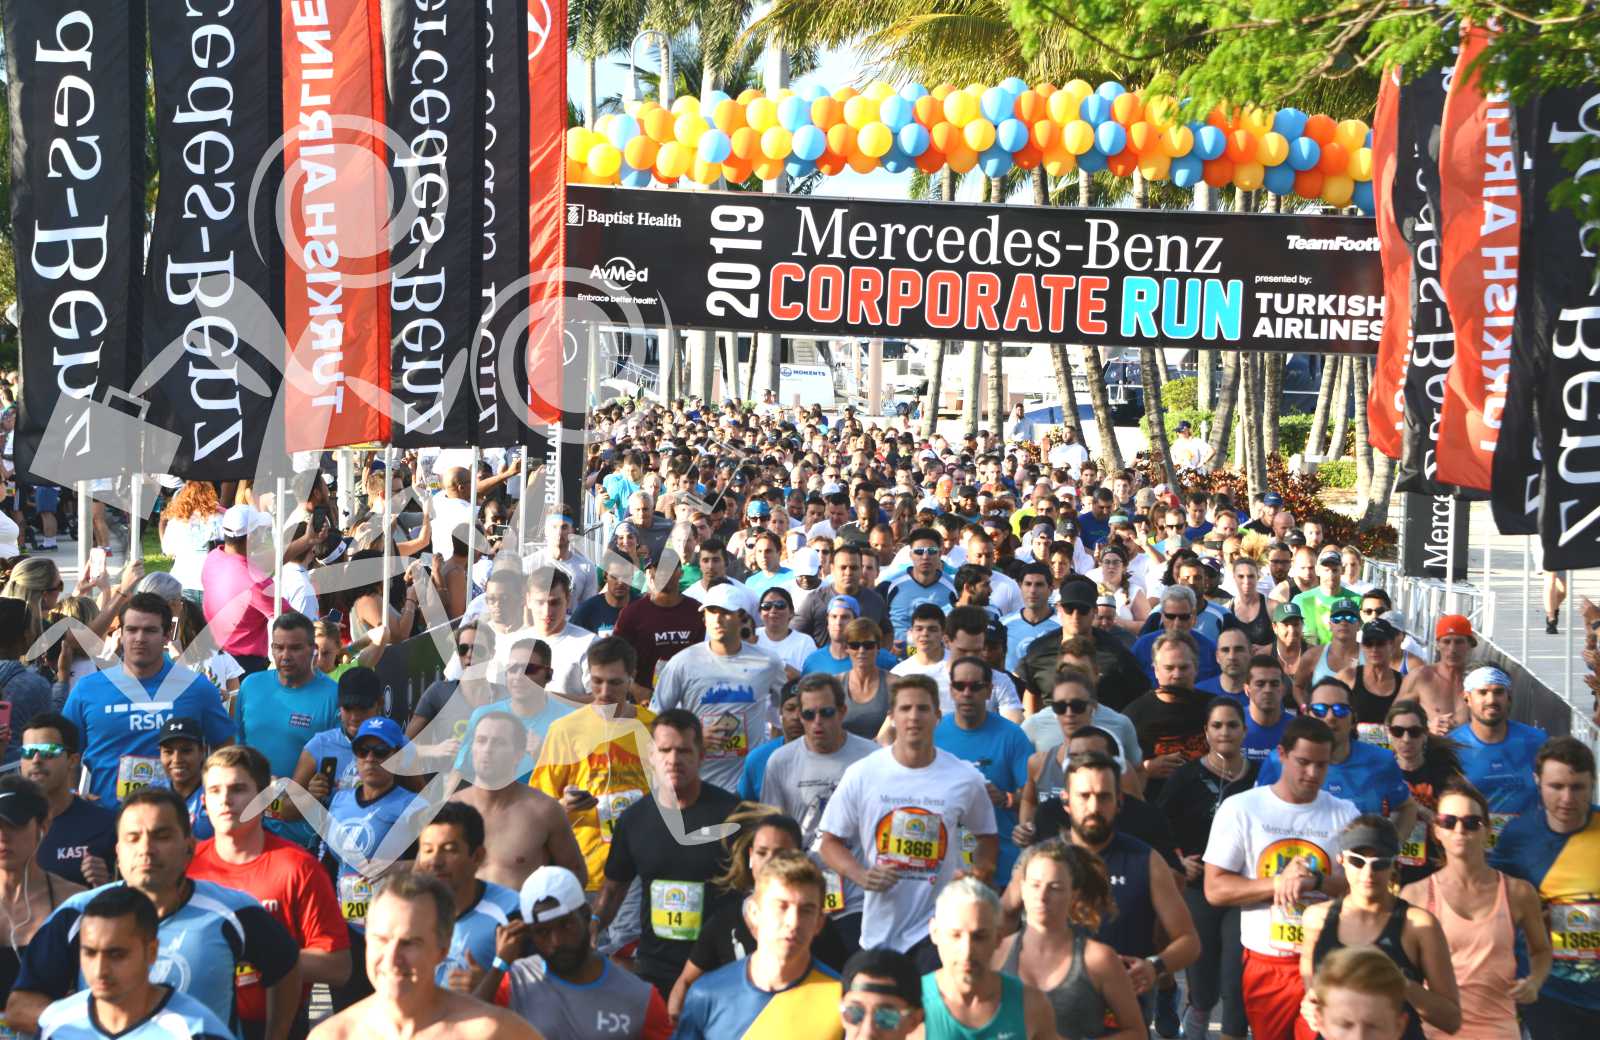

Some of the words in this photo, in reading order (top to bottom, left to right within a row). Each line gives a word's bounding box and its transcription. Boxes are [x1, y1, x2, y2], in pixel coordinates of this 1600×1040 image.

[587, 208, 634, 227] Baptist
[637, 212, 682, 228] Health
[792, 206, 1224, 275] Mercedes-Benz
[706, 204, 765, 318] 2019
[589, 265, 649, 283] AvMed
[1254, 275, 1298, 285] presented
[1298, 275, 1312, 286] by:
[577, 293, 610, 303] Embrace
[610, 295, 634, 305] better
[768, 262, 1110, 335] CORPORATE
[1121, 275, 1243, 341] RUN
[1255, 292, 1385, 317] TURKISH
[1252, 316, 1385, 342] AIRLINES
[655, 631, 691, 641] MTW
[895, 838, 933, 857] 1366
[666, 911, 683, 926] 14
